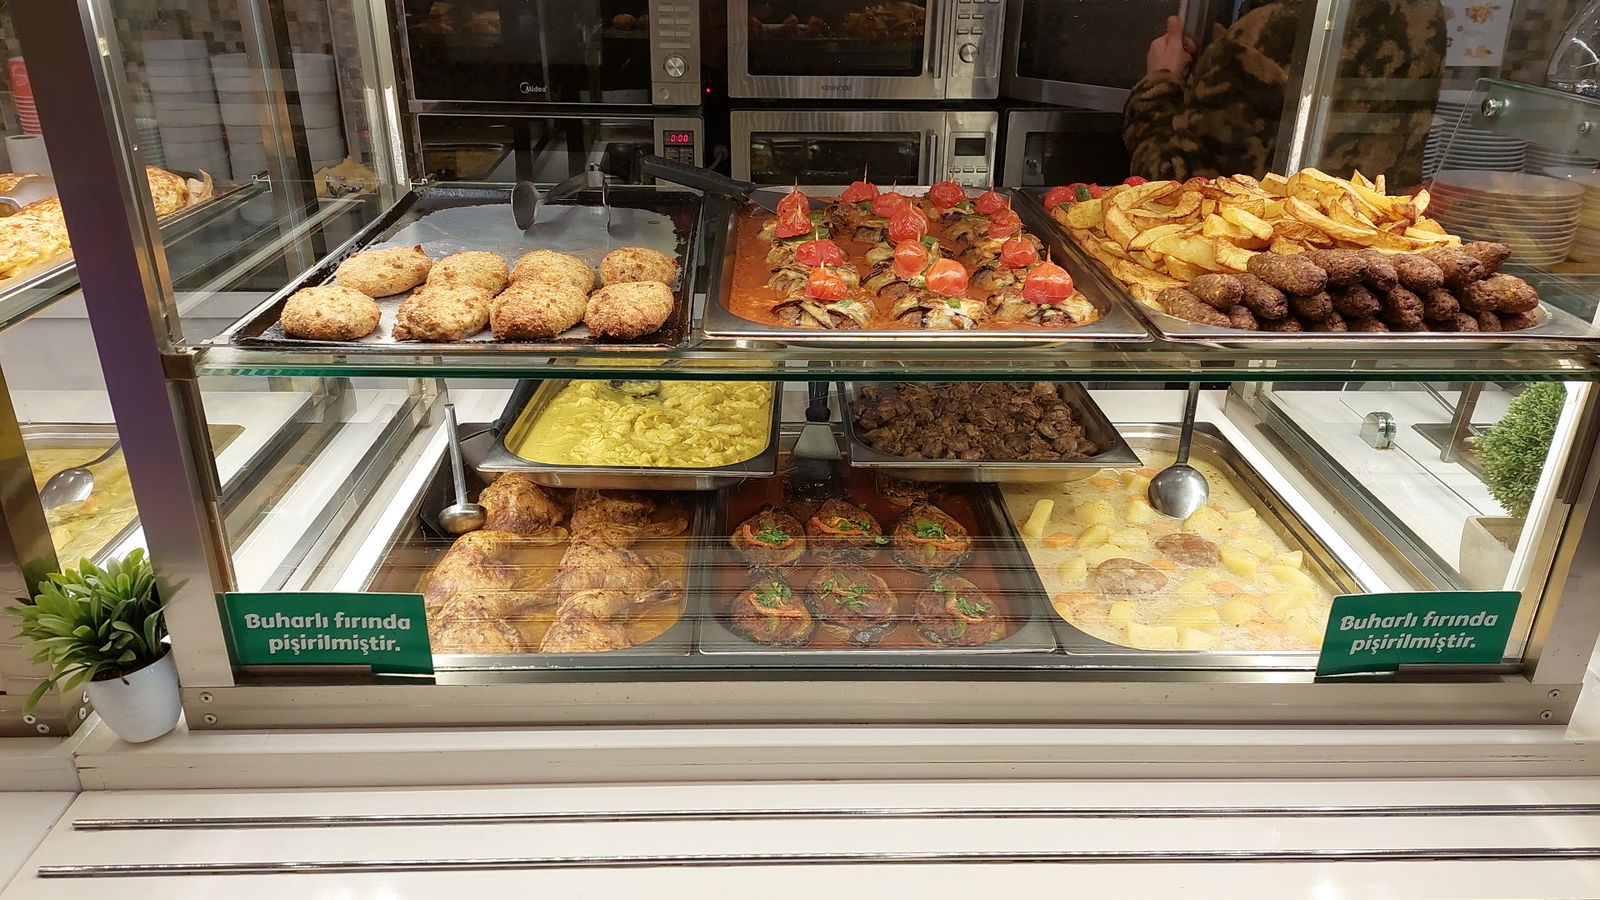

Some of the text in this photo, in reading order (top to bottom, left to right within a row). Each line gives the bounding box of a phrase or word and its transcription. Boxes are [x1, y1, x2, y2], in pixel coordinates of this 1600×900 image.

[519, 81, 547, 94] Midea
[670, 134, 689, 143] 0:00
[244, 611, 411, 630] Buharlı fırında
[1340, 611, 1498, 631] Buharlı fırında
[269, 633, 401, 655] pişirilmiştir.
[1349, 632, 1476, 655] pişirilmiştir.
